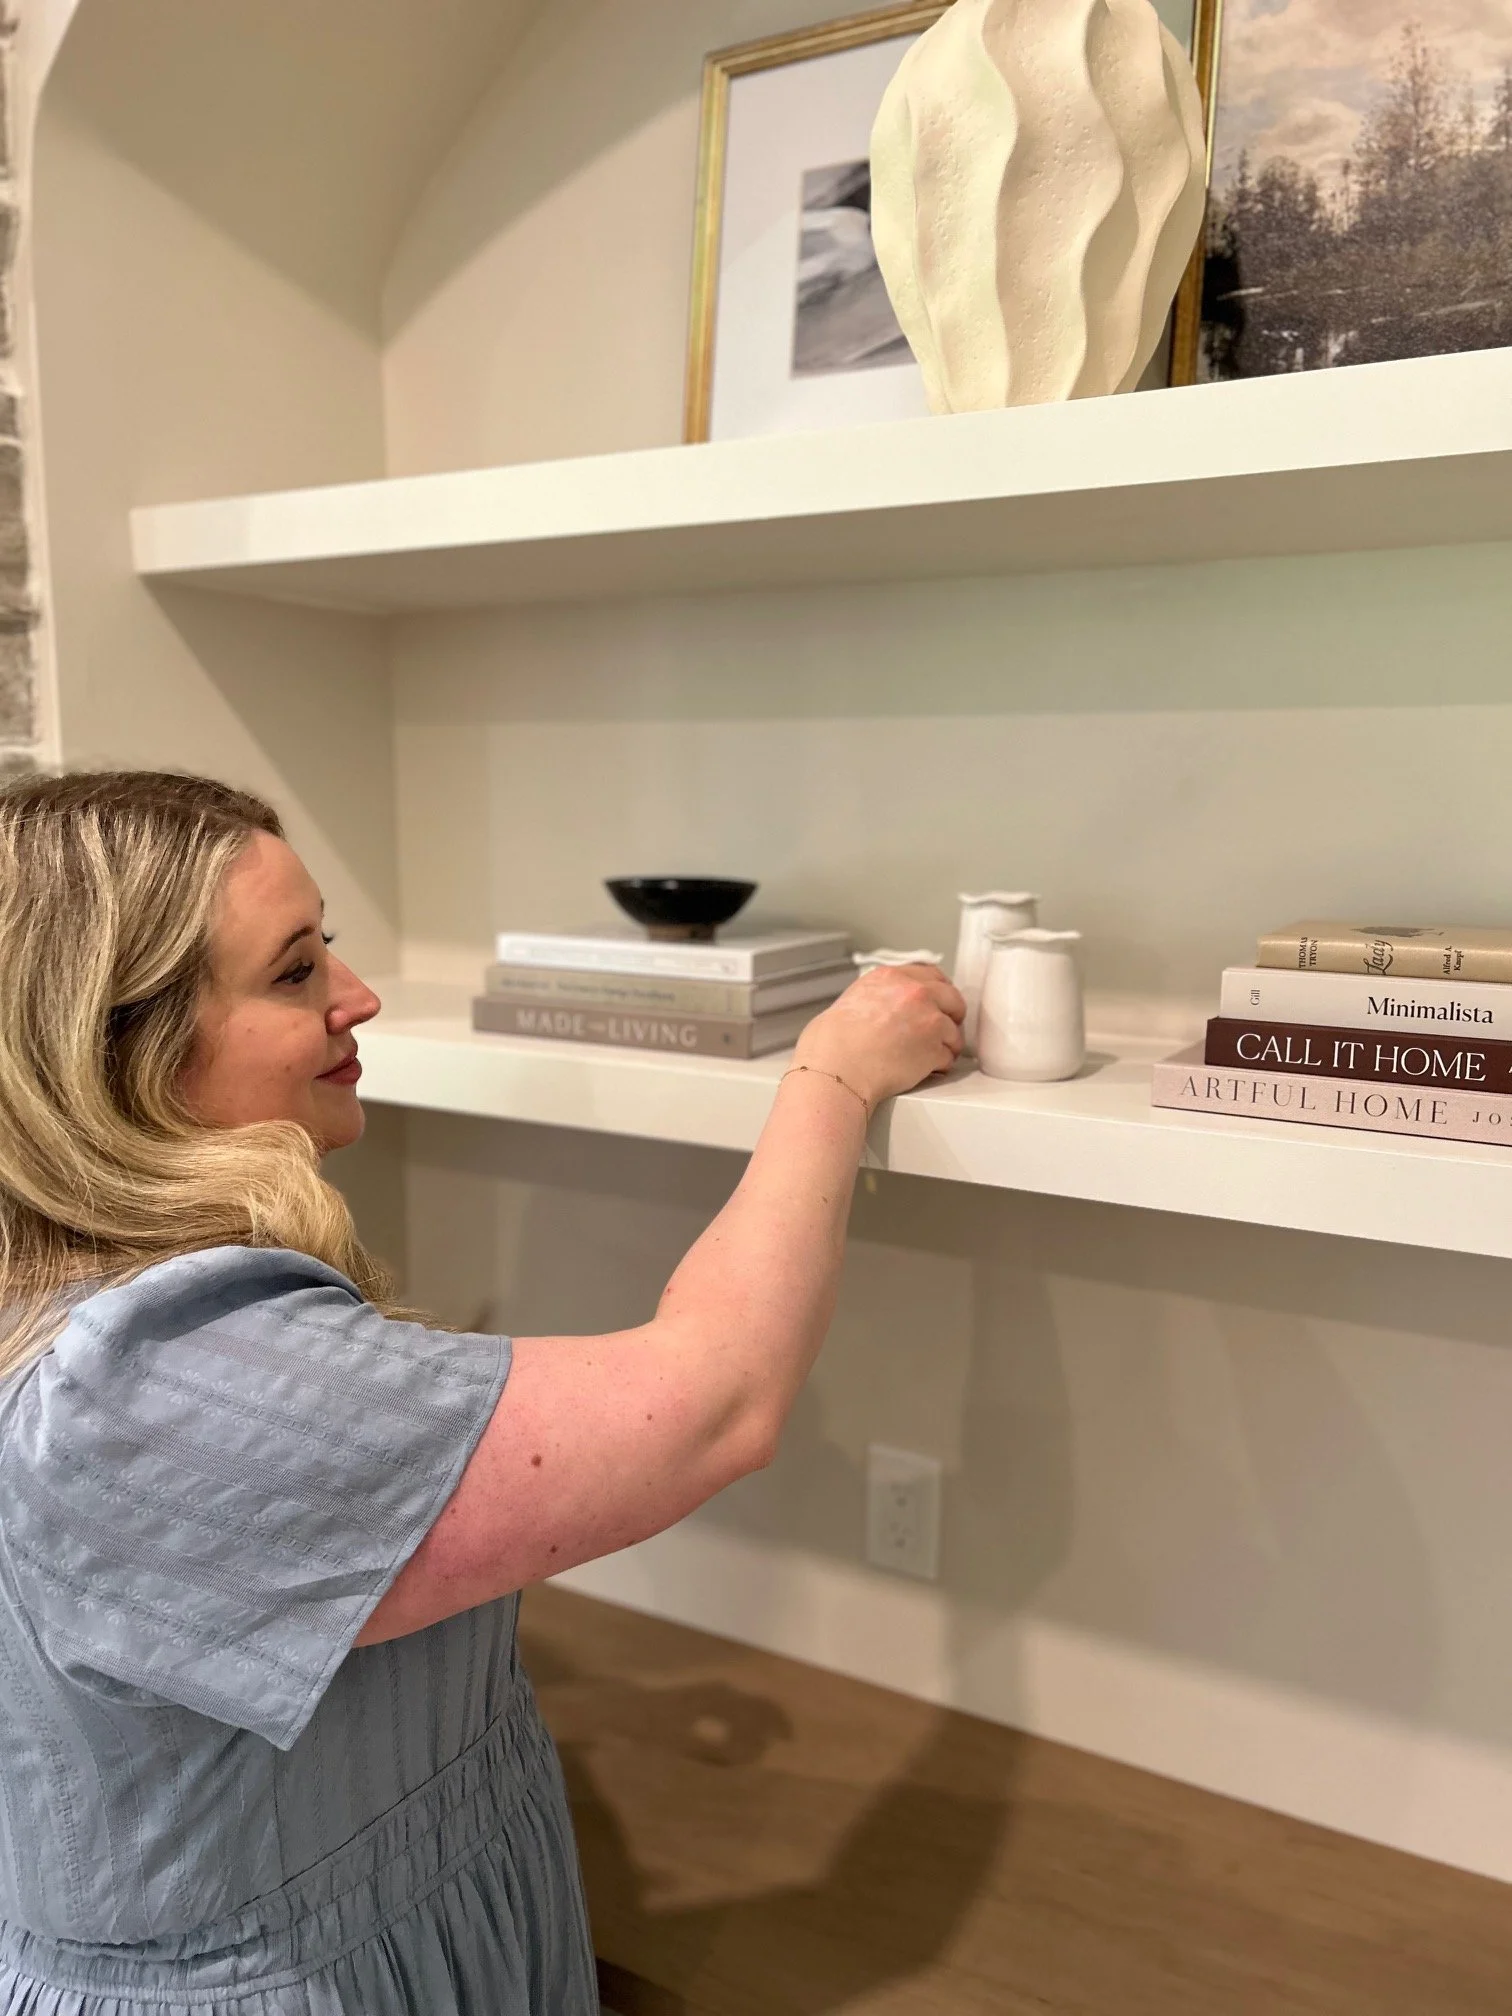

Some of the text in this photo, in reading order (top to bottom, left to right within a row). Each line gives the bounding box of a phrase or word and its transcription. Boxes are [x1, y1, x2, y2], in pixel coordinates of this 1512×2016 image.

[1299, 937, 1308, 968] THOMAS
[1310, 939, 1318, 966] TRYON
[1363, 940, 1393, 975] Lady
[1443, 954, 1451, 974] Alfred
[1250, 989, 1260, 1005] Gill
[1367, 996, 1494, 1023] Minimalista
[516, 1008, 698, 1046] MADE LIVING
[1236, 1033, 1486, 1081] CALL IT HOME
[1180, 1076, 1512, 1127] ARTFUL HOME JO
